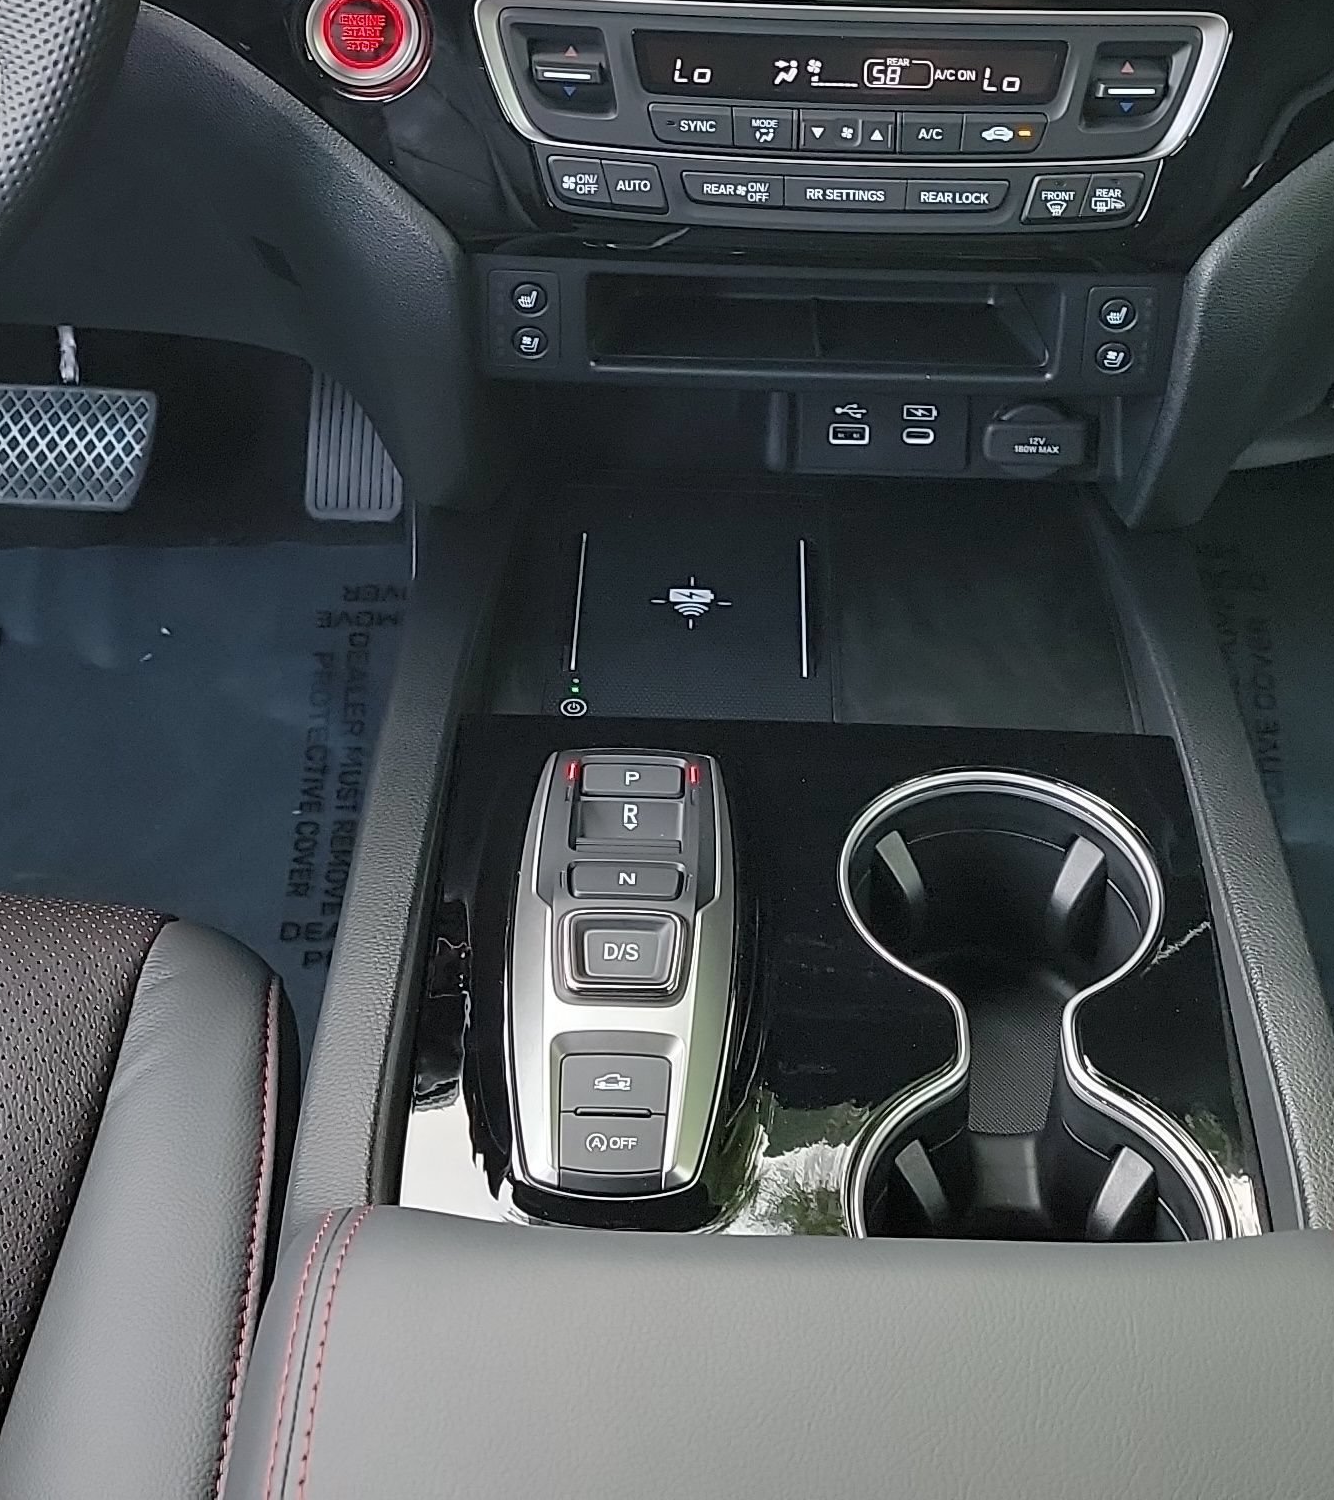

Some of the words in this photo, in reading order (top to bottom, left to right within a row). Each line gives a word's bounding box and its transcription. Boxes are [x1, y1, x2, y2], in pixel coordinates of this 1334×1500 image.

[340, 14, 386, 26] ENGINE
[343, 27, 382, 36] START
[347, 41, 379, 52] STOP
[886, 57, 910, 67] REAR
[934, 69, 956, 81] A/C
[957, 69, 976, 82] ON
[679, 120, 716, 133] SYNC
[751, 119, 779, 128] MODE
[917, 128, 943, 141] A/C
[576, 174, 598, 183] ON/
[576, 185, 599, 195] OFF
[616, 180, 651, 192] AUTO
[703, 183, 734, 196] REAR
[747, 182, 769, 192] ON/
[747, 192, 770, 202] OFF
[805, 188, 824, 201] RR
[825, 189, 885, 202] SETTINGS
[920, 191, 952, 204] REAR
[955, 191, 989, 205] LOCK
[1041, 190, 1075, 202] FRONT
[1095, 188, 1122, 199] REAR
[1029, 437, 1046, 445] 12V
[1038, 445, 1060, 454] MAX
[333, 746, 364, 813] MUST
[625, 771, 640, 785] P
[623, 804, 637, 824] R
[285, 820, 320, 899] COVER
[618, 873, 636, 885] N
[603, 943, 639, 961] D/S
[609, 1137, 637, 1149] OFF
